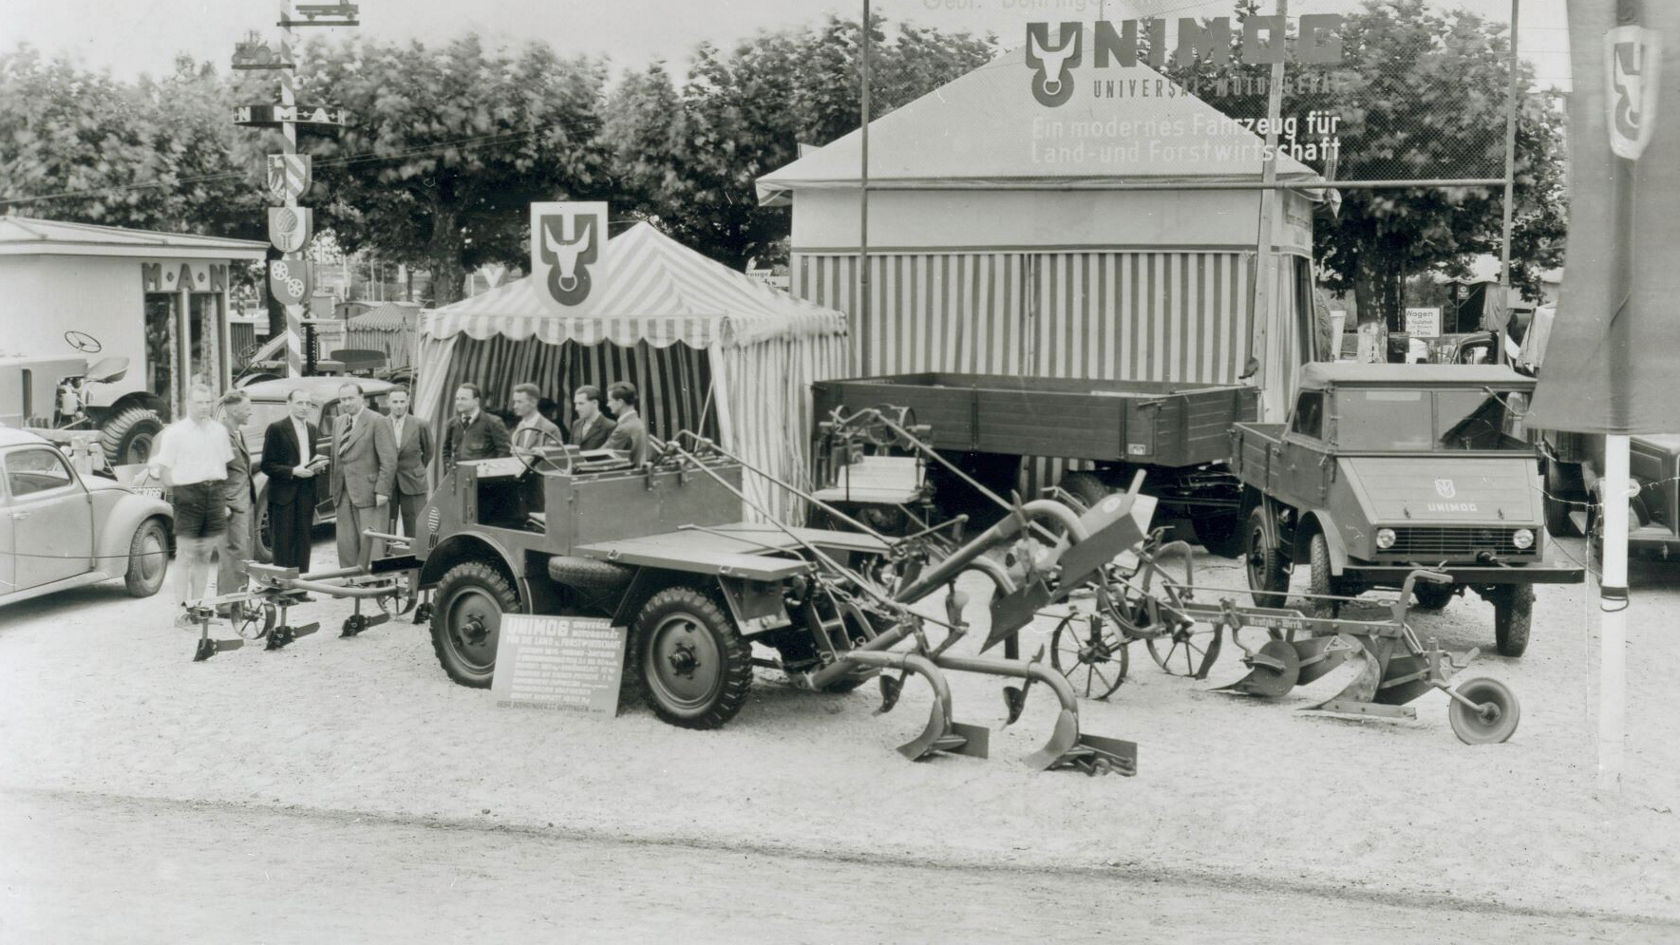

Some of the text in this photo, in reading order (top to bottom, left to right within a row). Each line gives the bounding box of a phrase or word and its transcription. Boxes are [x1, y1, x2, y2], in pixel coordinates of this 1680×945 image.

[1031, 110, 1341, 139] Ein modernes Fahrzeug für
[1149, 137, 1341, 163] Forstwirtschaft
